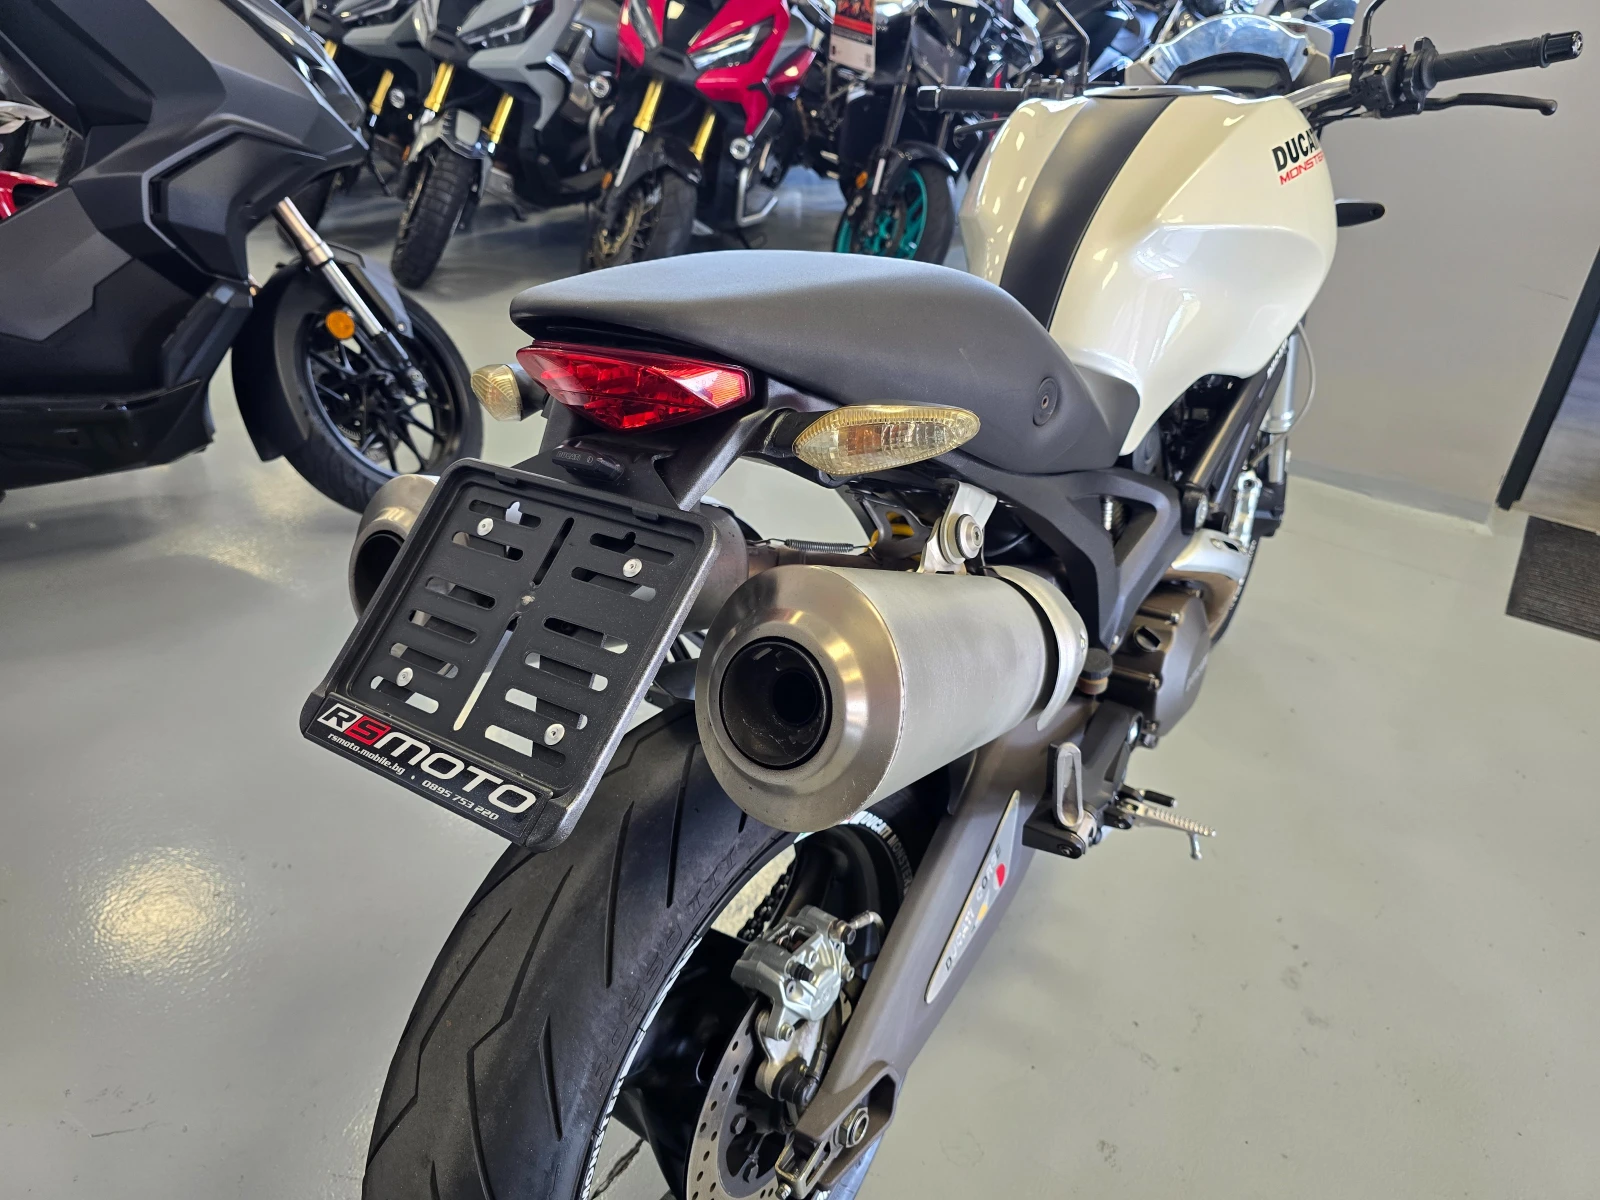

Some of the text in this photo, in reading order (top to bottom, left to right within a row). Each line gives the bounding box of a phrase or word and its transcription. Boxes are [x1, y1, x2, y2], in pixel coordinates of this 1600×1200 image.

[327, 733, 406, 775] rsmoto.mobile.bg
[421, 779, 500, 821] 0895 753 220
